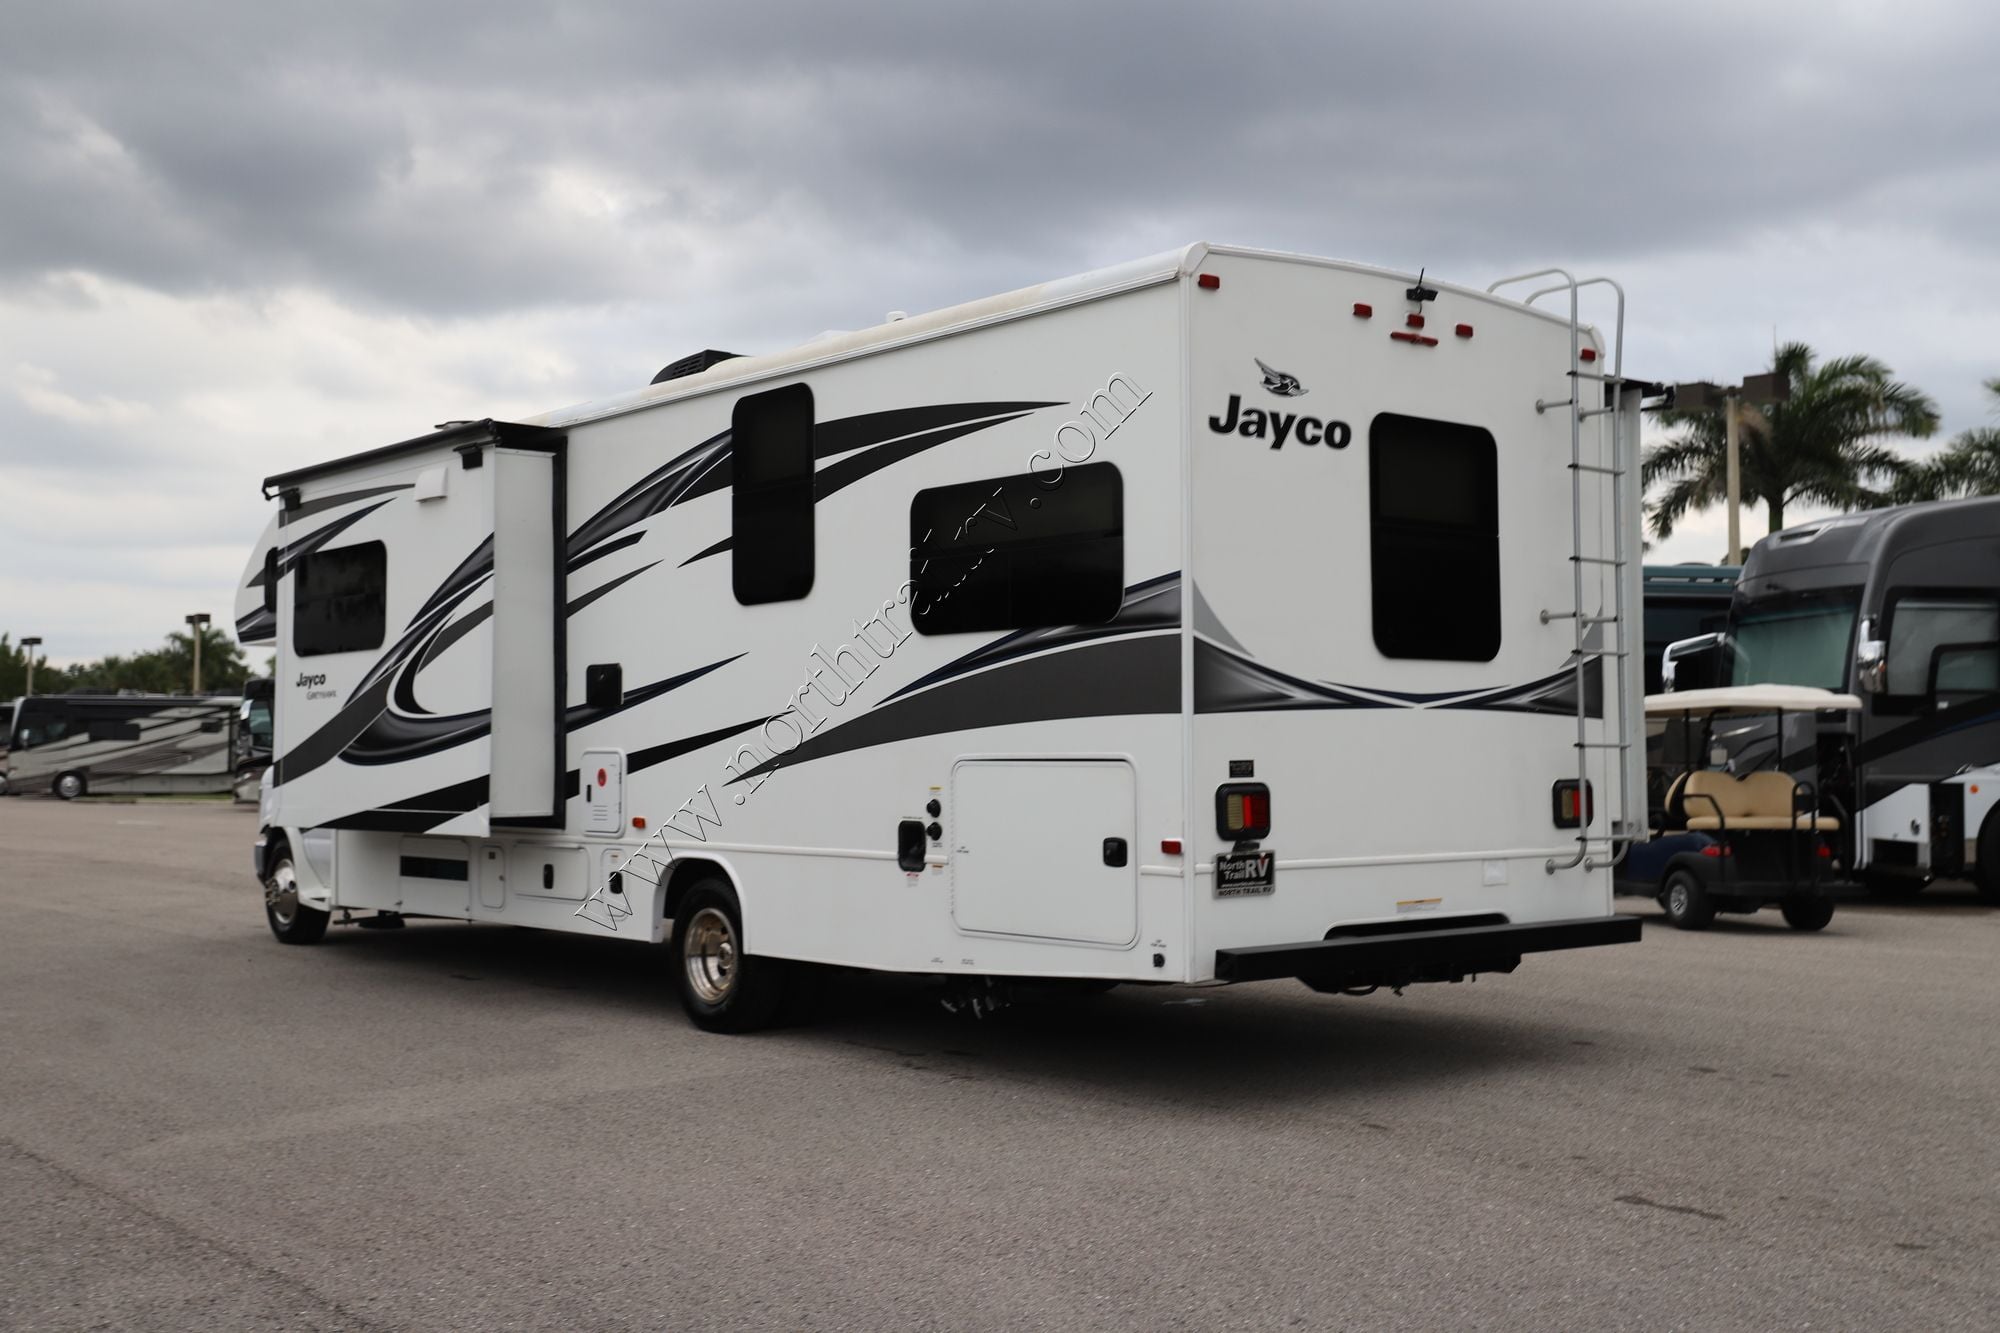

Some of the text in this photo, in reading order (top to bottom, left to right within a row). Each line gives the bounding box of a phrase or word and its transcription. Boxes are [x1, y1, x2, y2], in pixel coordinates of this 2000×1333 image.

[1208, 394, 1352, 450] Jayco
[296, 672, 326, 689] Jayco
[1219, 860, 1246, 871] North
[1245, 858, 1270, 878] RV
[1224, 869, 1246, 880] Trail
